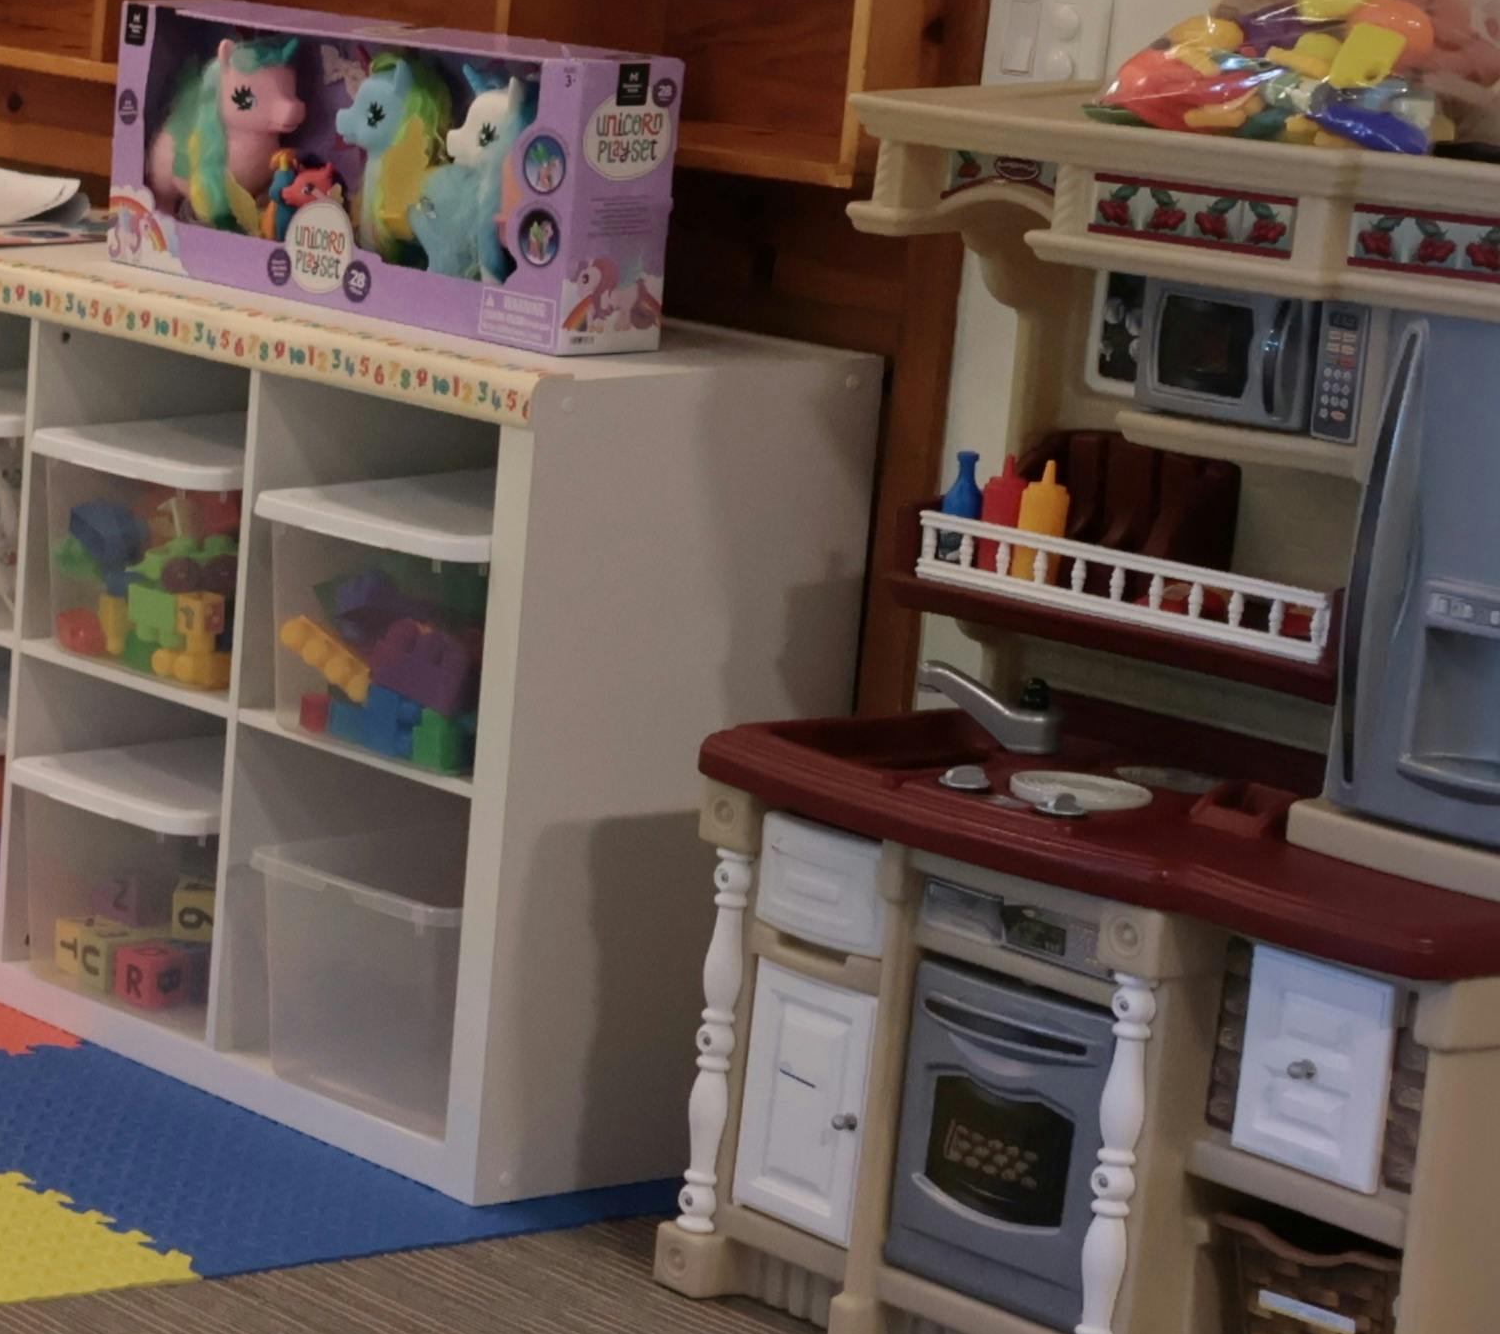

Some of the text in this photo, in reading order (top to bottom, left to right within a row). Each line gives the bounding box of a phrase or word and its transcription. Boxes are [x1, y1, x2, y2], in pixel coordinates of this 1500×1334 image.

[658, 85, 673, 97] 28
[349, 270, 366, 288] 28
[126, 963, 144, 999] R
